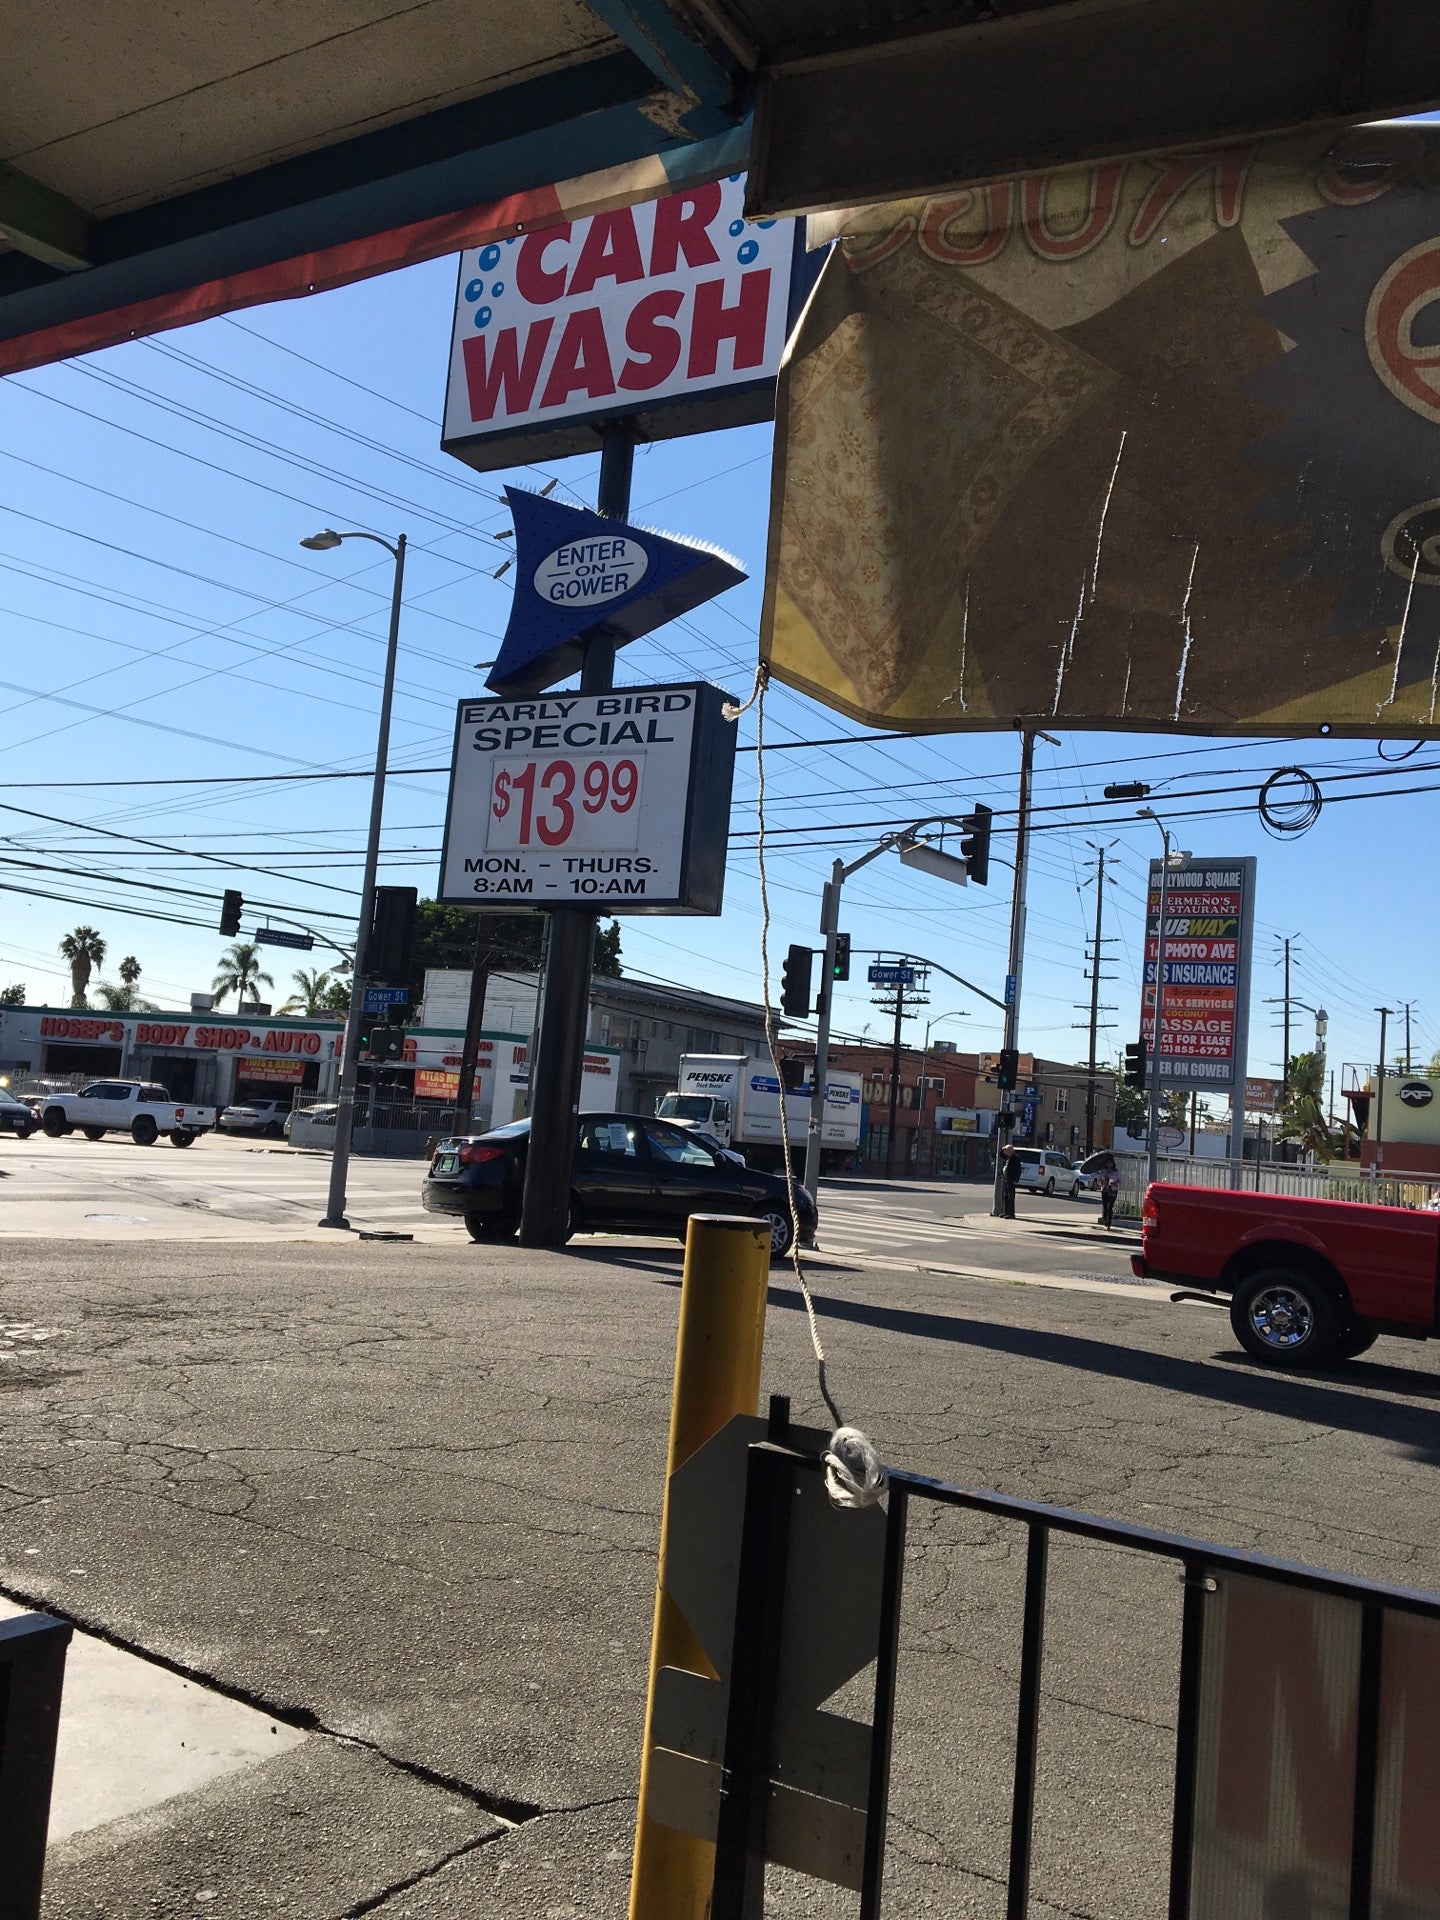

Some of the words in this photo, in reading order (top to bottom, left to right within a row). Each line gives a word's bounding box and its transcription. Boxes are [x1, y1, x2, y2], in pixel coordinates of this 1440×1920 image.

[515, 180, 722, 305] CAR
[462, 268, 772, 423] WASH
[557, 540, 626, 567] ENTER
[575, 563, 606, 577] ON
[550, 573, 629, 600] GOWER
[464, 701, 579, 725] EARLY
[596, 694, 692, 717] BIRD
[472, 720, 674, 752] SPECIAL
[464, 858, 527, 874] MON.
[562, 857, 659, 874] THURS.
[474, 878, 534, 894] 8:AM
[570, 878, 647, 894] 10:AM
[1151, 872, 1204, 888] HOLYWOOD
[1205, 872, 1241, 889] SQUARE
[1161, 893, 1231, 906] ERMEÑO'S
[1152, 905, 1238, 914] RSTAURANT
[1148, 918, 1237, 936] SUBWAY
[1165, 943, 1208, 958] PHOTO
[1209, 944, 1236, 959] AVE
[872, 969, 899, 979] Gower
[901, 970, 911, 979] St
[1171, 964, 1235, 984] INSURANCE
[368, 990, 392, 1001] Gower
[394, 990, 404, 1001] St
[1165, 998, 1184, 1008] TAX
[1185, 999, 1234, 1009] SERVICES
[1165, 1010, 1209, 1018] COCONUT
[1142, 1018, 1232, 1033] MASSAGE
[40, 1017, 125, 1042] HOSEP'S
[135, 1024, 190, 1046] BODY
[194, 1026, 251, 1050] SHOP
[262, 1030, 322, 1055] AUTO
[1143, 1032, 1174, 1044] SPCE
[1176, 1034, 1197, 1045] FOR
[1200, 1035, 1231, 1046] LEASE
[420, 1070, 446, 1083] ATLAS
[687, 1072, 734, 1083] PENSKE
[1174, 1061, 1189, 1076] ON
[1190, 1063, 1230, 1078] GOWER
[829, 1089, 850, 1099] PENSKE
